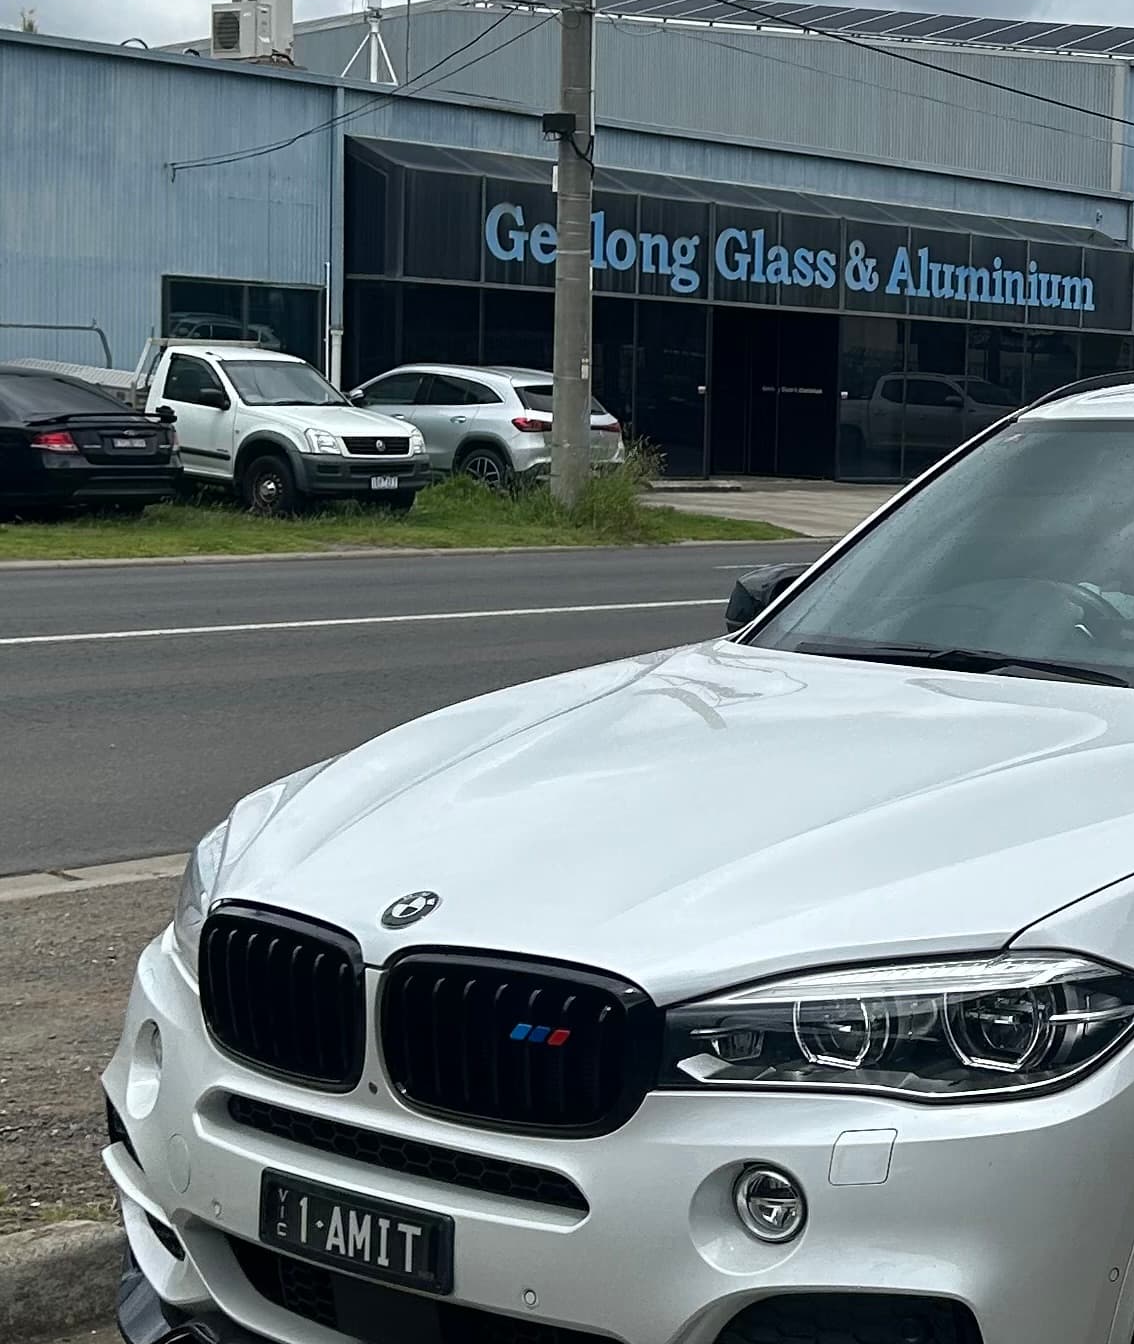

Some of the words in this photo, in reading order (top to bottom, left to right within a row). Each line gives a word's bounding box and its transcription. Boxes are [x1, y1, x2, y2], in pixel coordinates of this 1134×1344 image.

[485, 202, 700, 294] Gelong
[714, 227, 837, 288] Glass
[845, 240, 879, 292] &
[886, 246, 1096, 312] Aluminium
